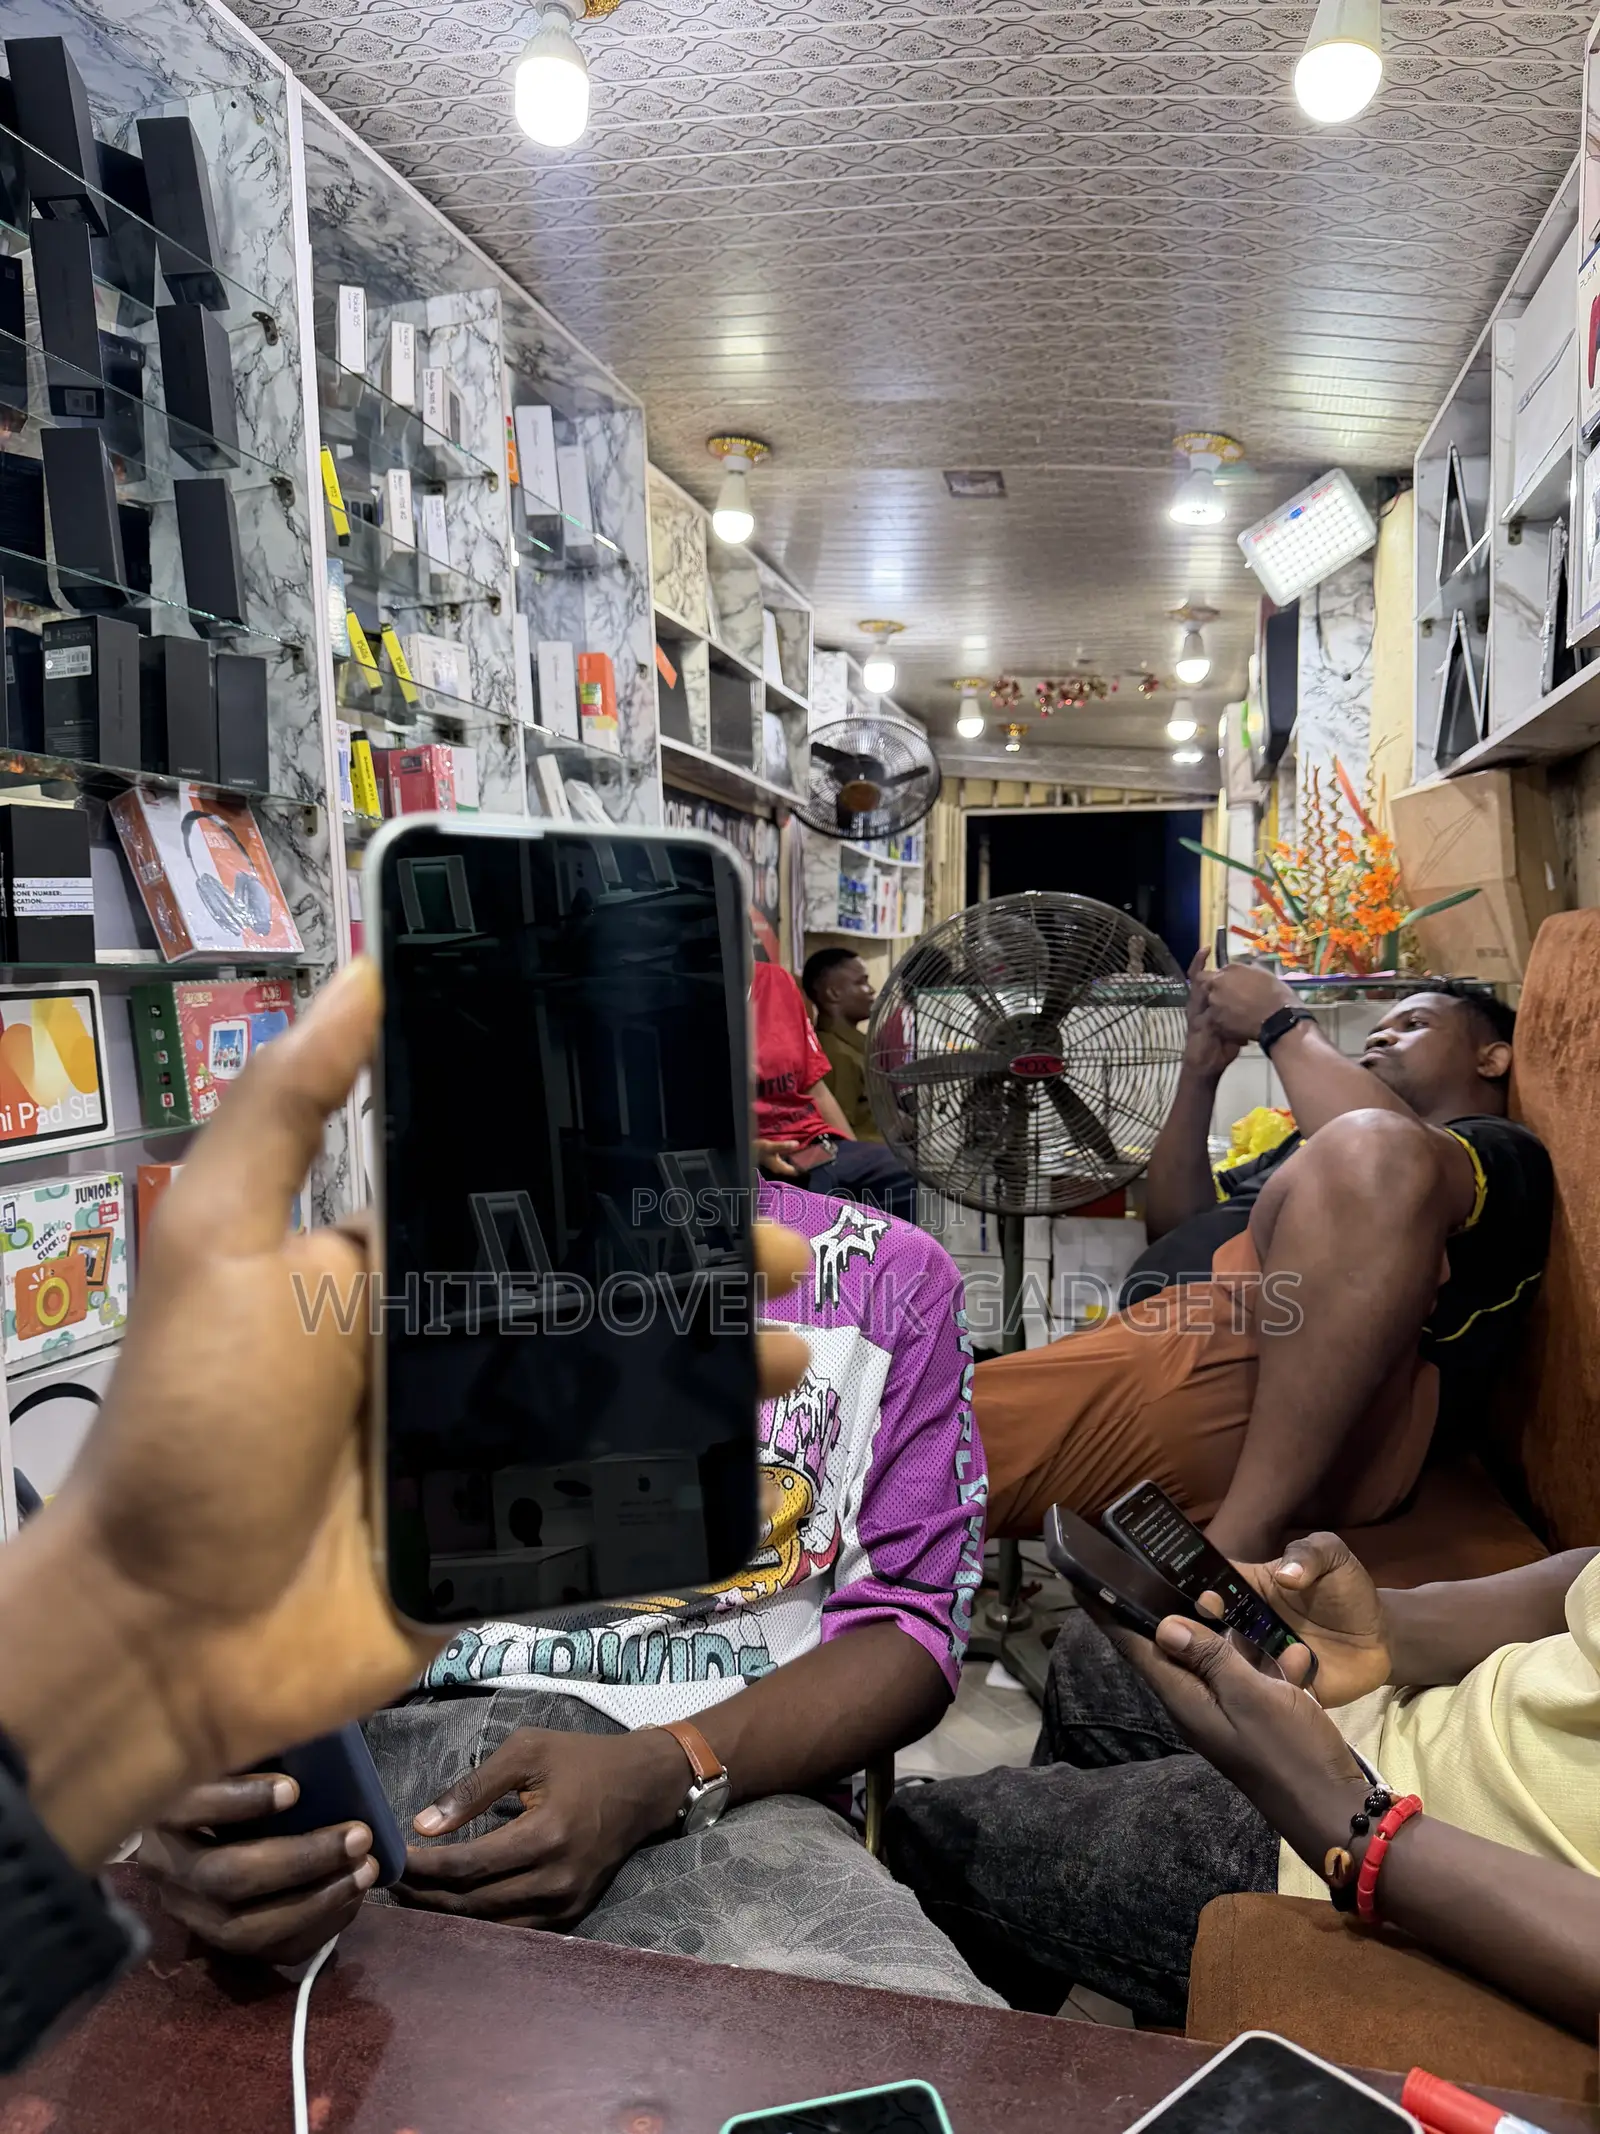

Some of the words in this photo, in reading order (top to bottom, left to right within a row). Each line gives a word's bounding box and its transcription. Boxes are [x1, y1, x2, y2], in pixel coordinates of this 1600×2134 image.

[18, 1097, 63, 1130] Pad
[69, 1093, 98, 1121] SE
[75, 1181, 113, 1205] JUNIOR
[32, 1226, 57, 1251] CLICK!
[37, 1236, 61, 1261] CLICK!
